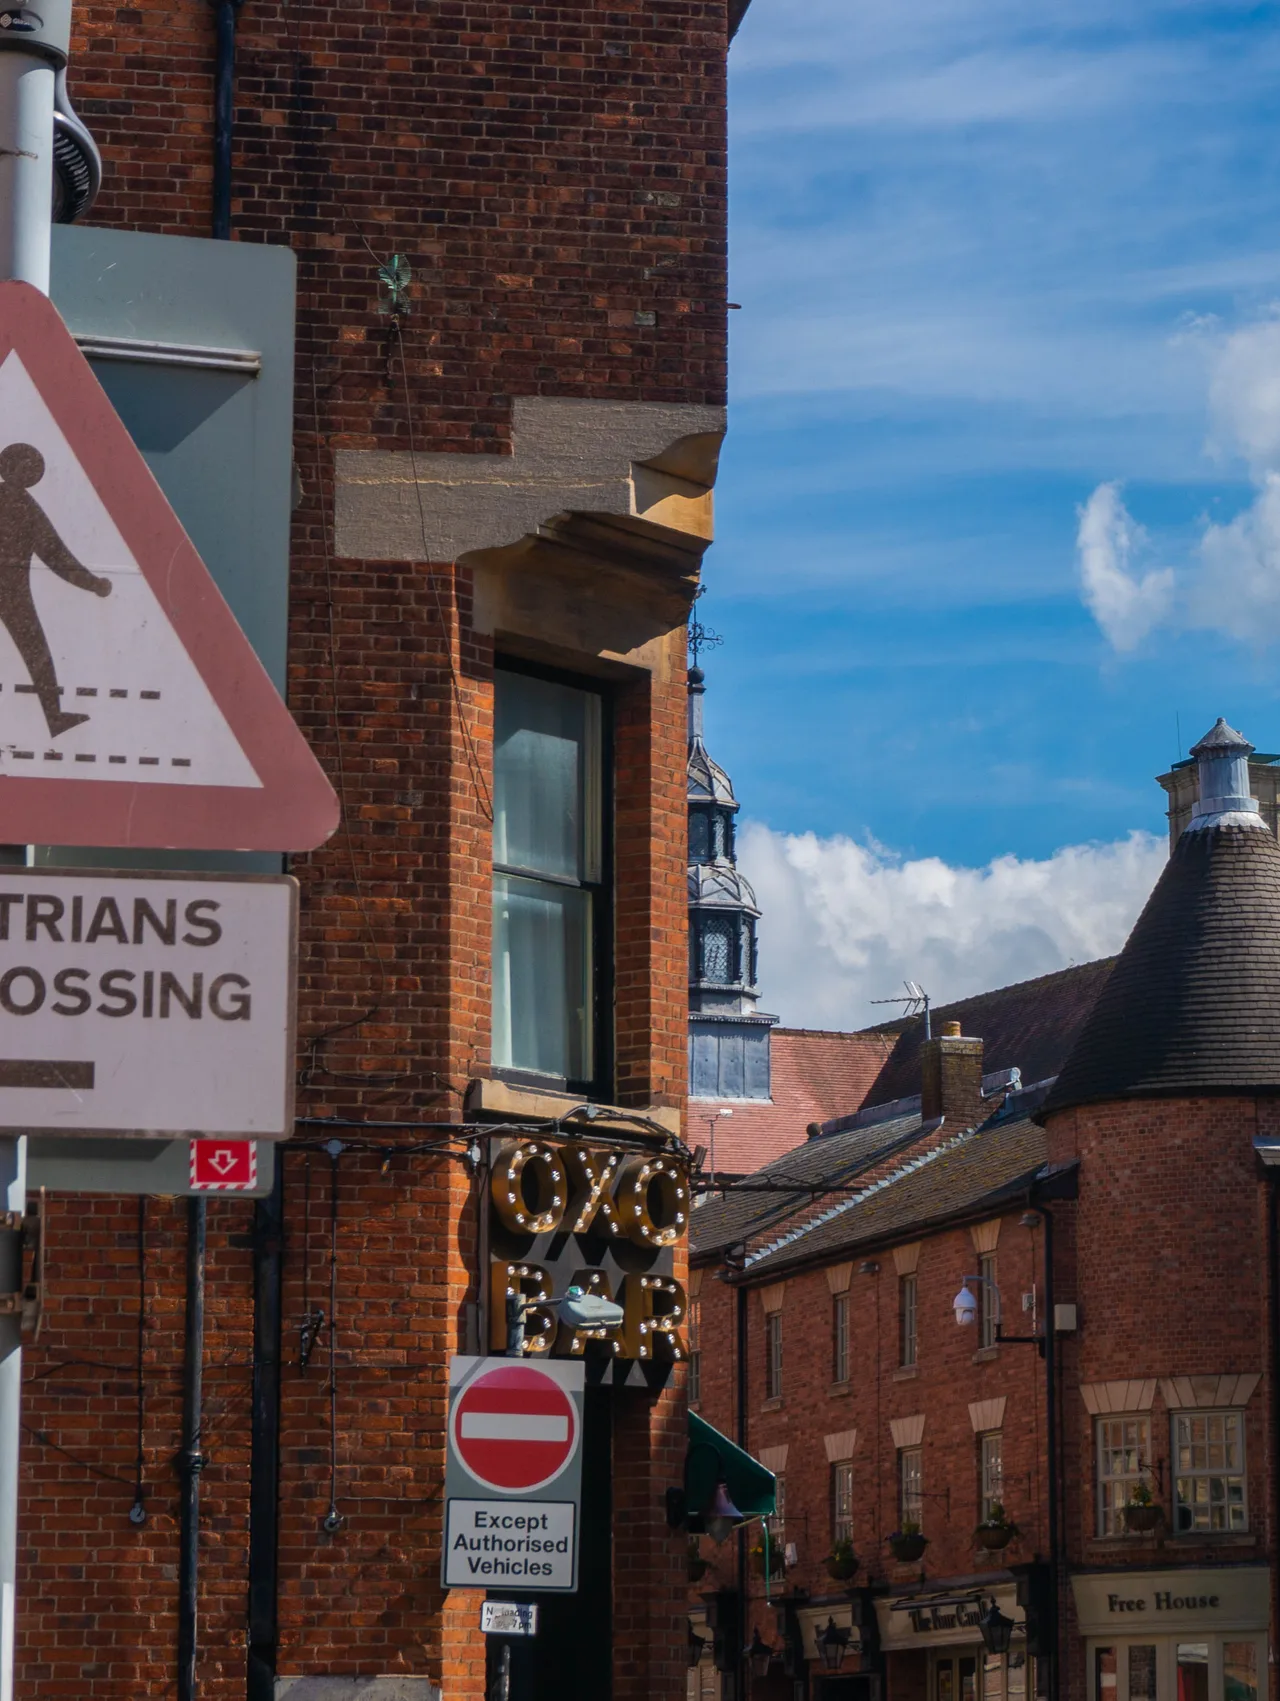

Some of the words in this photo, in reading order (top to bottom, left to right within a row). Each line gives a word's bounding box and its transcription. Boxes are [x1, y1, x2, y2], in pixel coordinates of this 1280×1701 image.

[0, 893, 223, 947] TRIANS
[0, 966, 252, 1021] OSSING
[491, 1141, 689, 1247] OXO
[490, 1260, 689, 1361] BAR
[474, 1511, 549, 1533] Except
[453, 1533, 569, 1554] Authorised
[467, 1556, 553, 1576] Vehicles
[1108, 1593, 1146, 1613] Free
[1154, 1590, 1220, 1611] House
